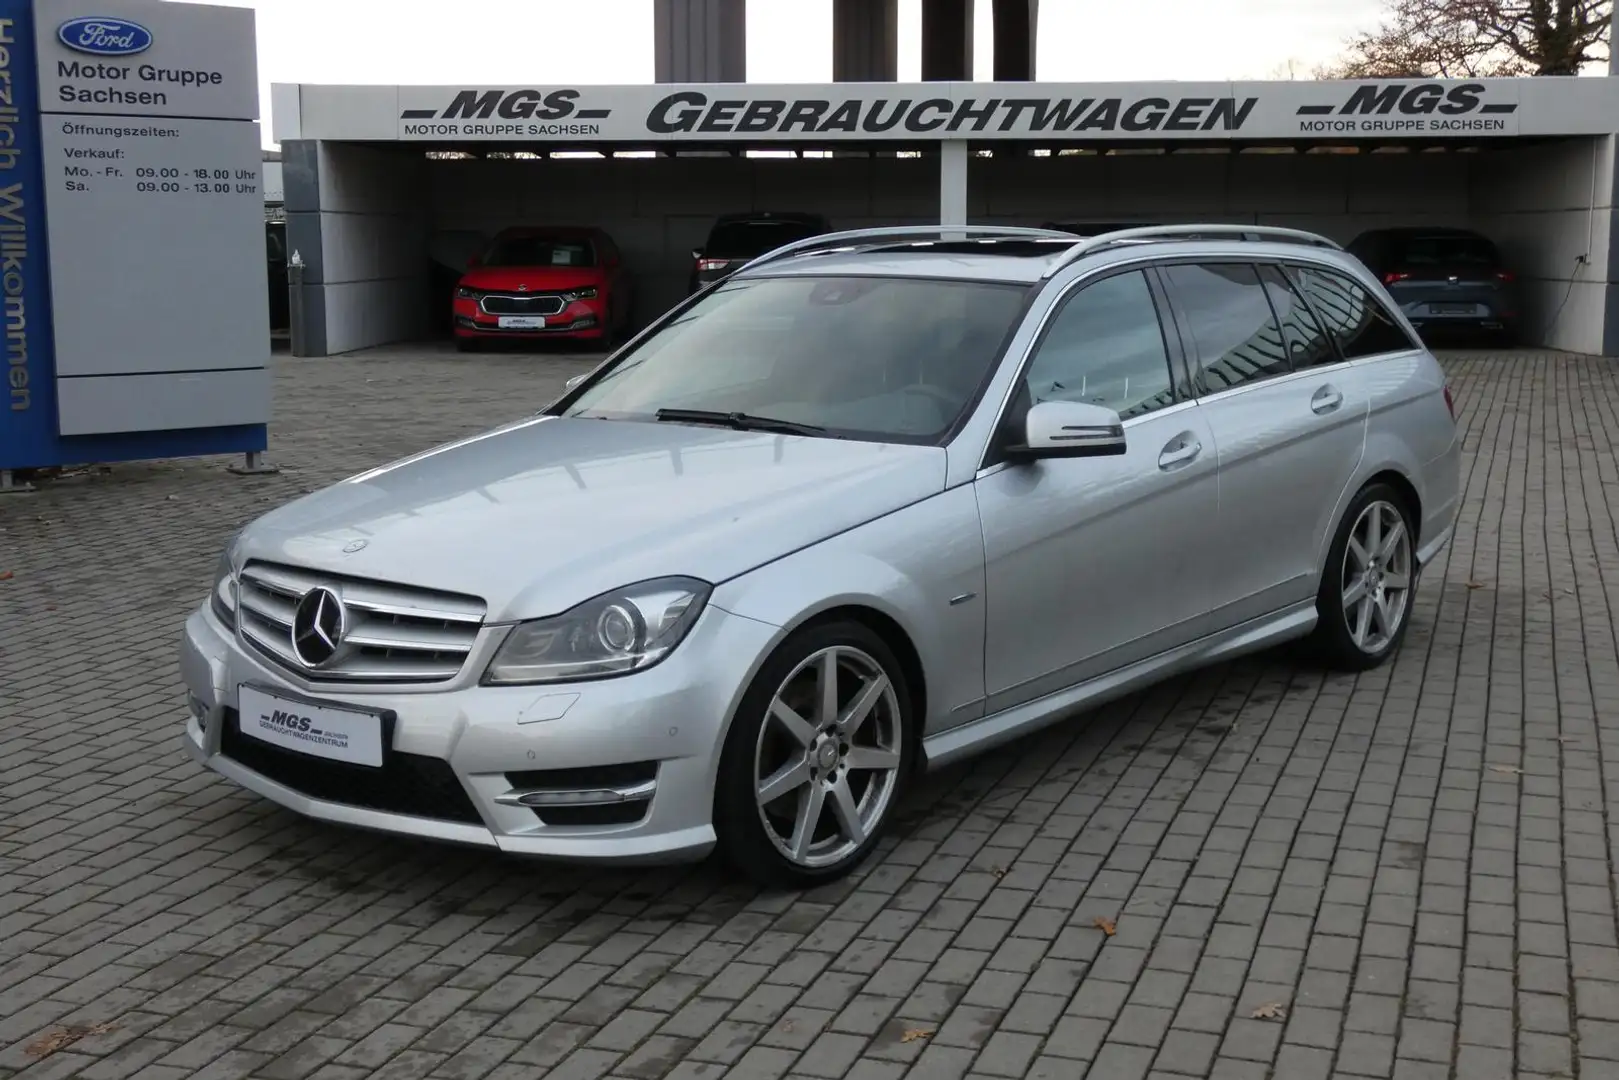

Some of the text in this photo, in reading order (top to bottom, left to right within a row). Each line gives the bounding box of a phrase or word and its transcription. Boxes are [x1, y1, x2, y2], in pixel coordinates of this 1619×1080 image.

[79, 22, 135, 48] Ford
[57, 60, 222, 87] Motor Gruppe
[59, 85, 167, 105] Sachsen
[441, 89, 581, 120] MGS
[1337, 83, 1486, 115] MGS
[645, 91, 1259, 134] GEBRAUCHTWAGEN
[62, 122, 180, 138] Öffnungszeiten:
[405, 124, 599, 135] MOTOR GRUPPE SACHSEN
[1300, 119, 1505, 131] MOTOR GRUPPE SACHSEN
[64, 148, 124, 159] Verkauf:
[64, 166, 93, 177] Mo.
[105, 167, 123, 177] Fr.
[136, 167, 179, 178] 09.00
[193, 168, 229, 179] 18.00
[235, 169, 256, 180] Uhr
[65, 180, 89, 191] Sa.
[137, 182, 180, 192] 09.00
[194, 183, 230, 193] 13.00
[236, 184, 256, 194] Uhr
[0, 182, 31, 411] Willkommen
[271, 709, 312, 732] MGS
